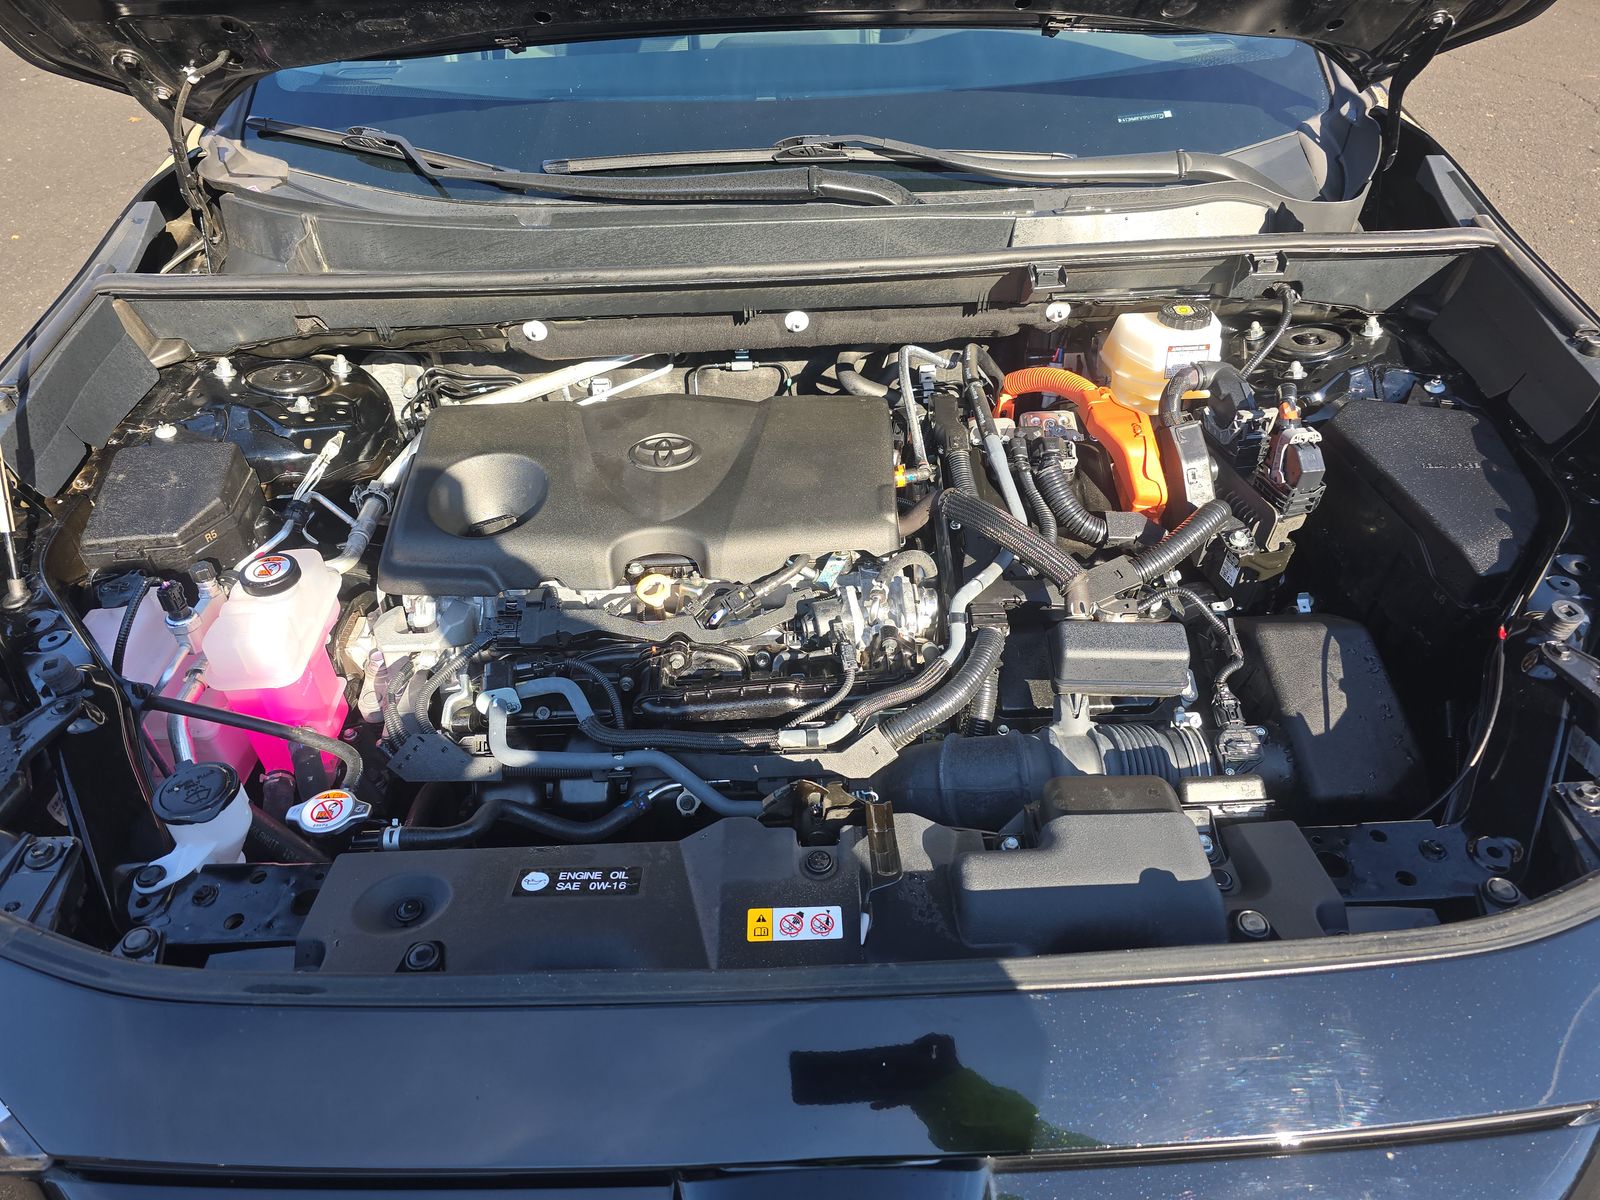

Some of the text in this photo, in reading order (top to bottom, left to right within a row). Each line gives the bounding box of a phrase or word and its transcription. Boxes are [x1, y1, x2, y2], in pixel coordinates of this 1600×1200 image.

[204, 529, 218, 543] R5
[558, 871, 629, 880] ENGINE OIL
[555, 881, 627, 891] SAE 0W-16
